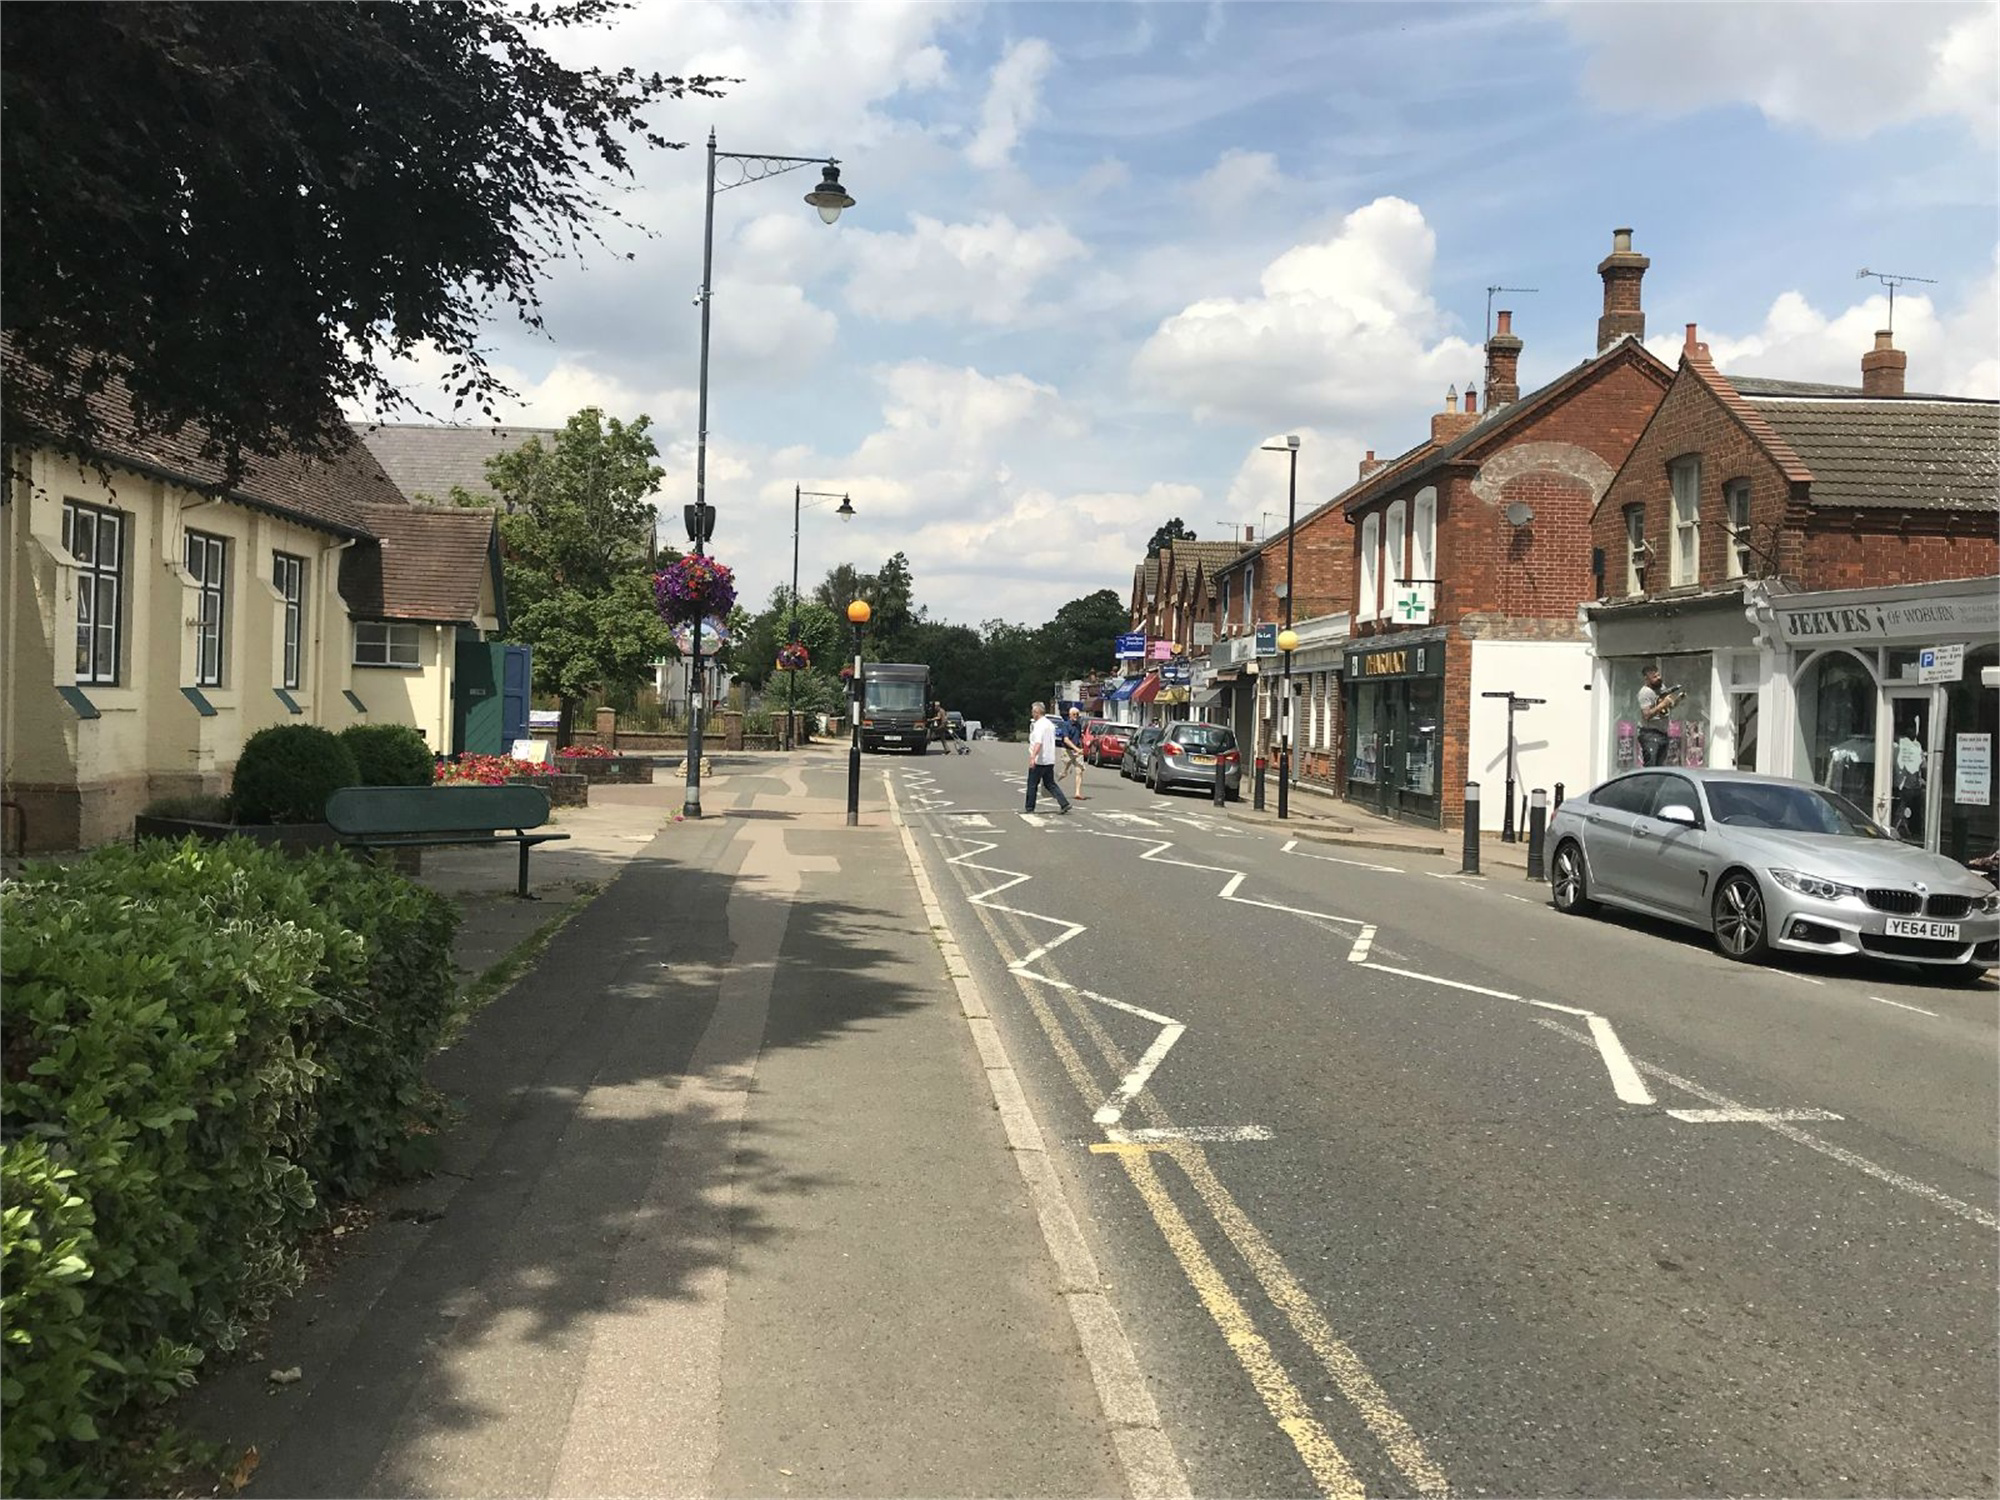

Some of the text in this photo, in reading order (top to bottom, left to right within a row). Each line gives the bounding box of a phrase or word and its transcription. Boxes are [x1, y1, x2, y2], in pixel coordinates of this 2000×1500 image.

[1787, 608, 1871, 635] JEEVES
[1887, 611, 1900, 624] OF
[1903, 605, 1955, 624] WOBURN
[1924, 653, 1933, 667] P
[1891, 920, 1955, 938] YE64 EUH
